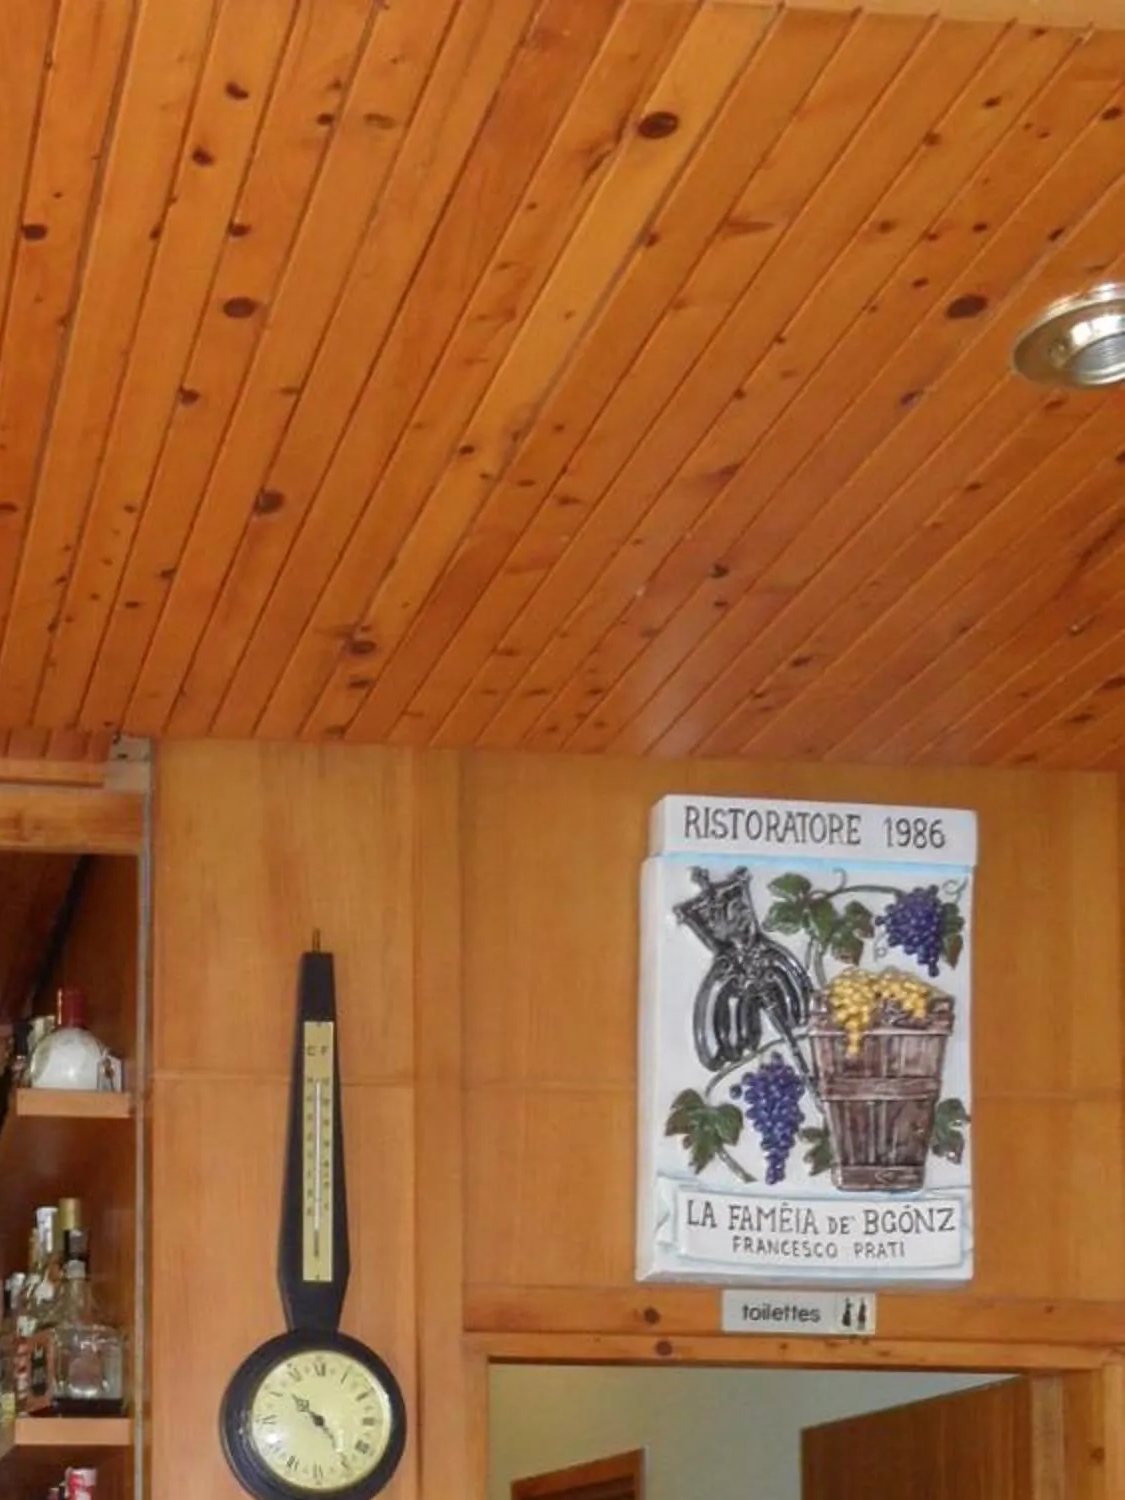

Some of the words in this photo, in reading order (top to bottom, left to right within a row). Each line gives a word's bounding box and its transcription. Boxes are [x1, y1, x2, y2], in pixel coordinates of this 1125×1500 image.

[683, 805, 862, 846] RISTORATORE
[883, 816, 946, 849] 1986
[686, 1200, 718, 1229] LA
[732, 1236, 838, 1259] FRANCESCO
[854, 1241, 905, 1259] PRATI
[742, 1303, 821, 1322] toilettes
